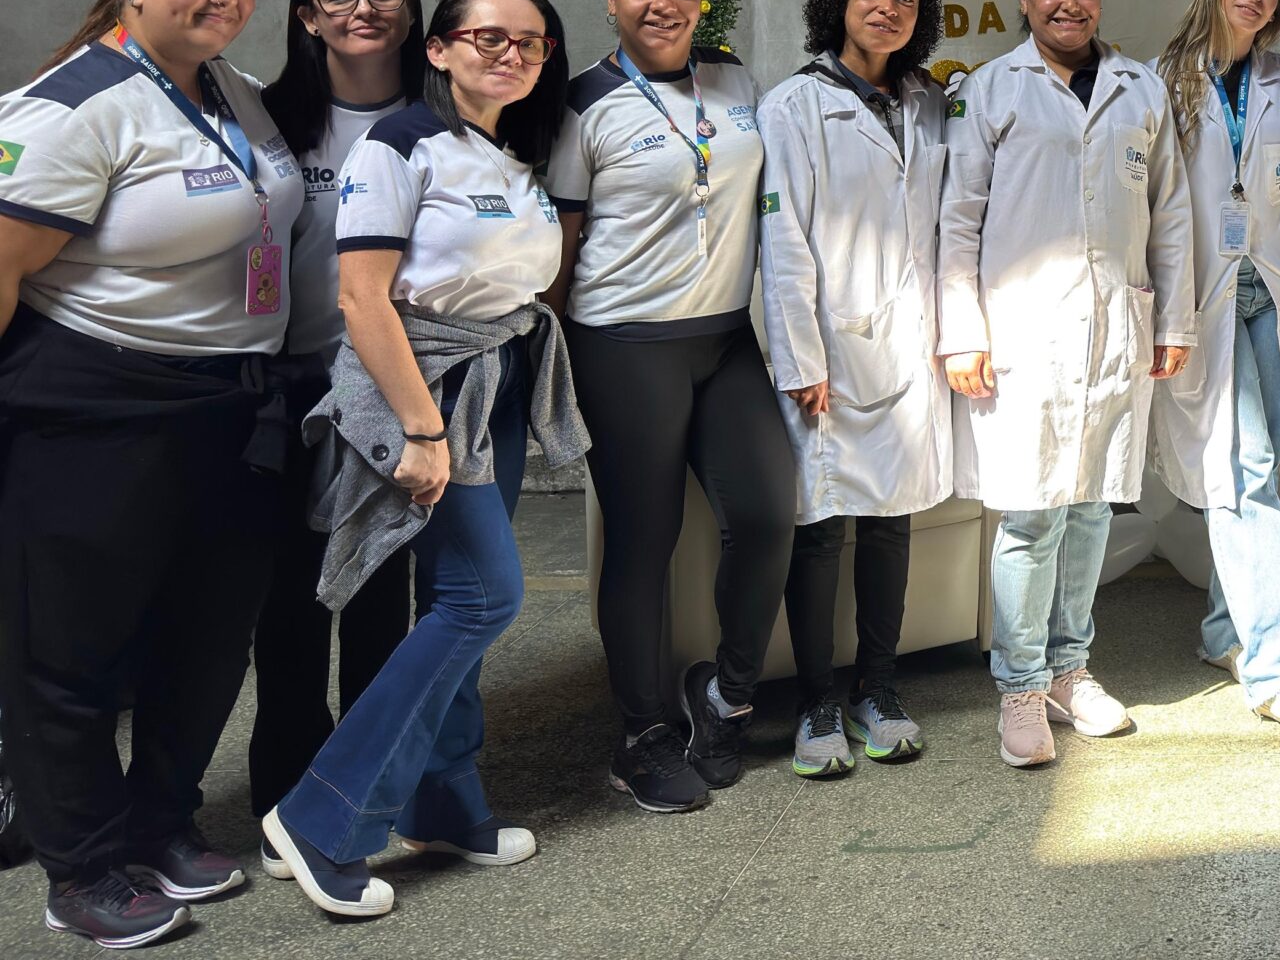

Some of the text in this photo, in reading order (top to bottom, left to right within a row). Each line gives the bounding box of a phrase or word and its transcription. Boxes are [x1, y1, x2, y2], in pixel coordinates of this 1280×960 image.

[944, 1, 1006, 38] DA
[140, 56, 161, 78] SAÚDE
[211, 170, 233, 182] RIO
[305, 183, 336, 191] ITURA
[491, 200, 508, 208] RIO
